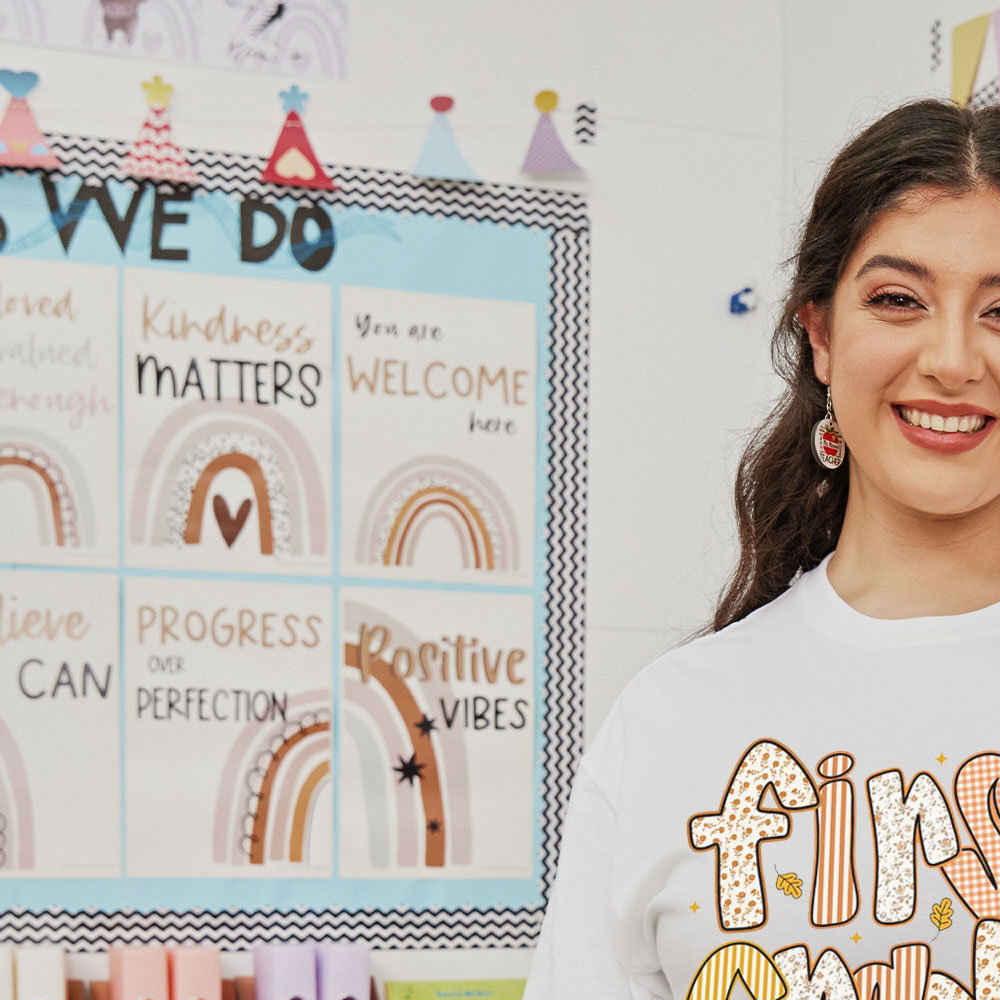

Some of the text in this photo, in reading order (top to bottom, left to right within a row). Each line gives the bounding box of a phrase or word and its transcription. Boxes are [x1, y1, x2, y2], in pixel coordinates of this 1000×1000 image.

[41, 174, 190, 262] WE
[240, 197, 337, 272] DO
[0, 288, 79, 321] oved
[142, 295, 317, 354] Kindness
[355, 312, 444, 342] You are
[136, 354, 323, 407] MATTERS
[347, 354, 530, 407] WELCOME
[468, 411, 517, 436] here
[137, 604, 324, 649] PROGRESS
[148, 654, 187, 674] OVER
[358, 622, 528, 686] Positive
[19, 658, 113, 700] CAN
[136, 686, 289, 722] PERFECTION
[440, 696, 531, 731] VIBES
